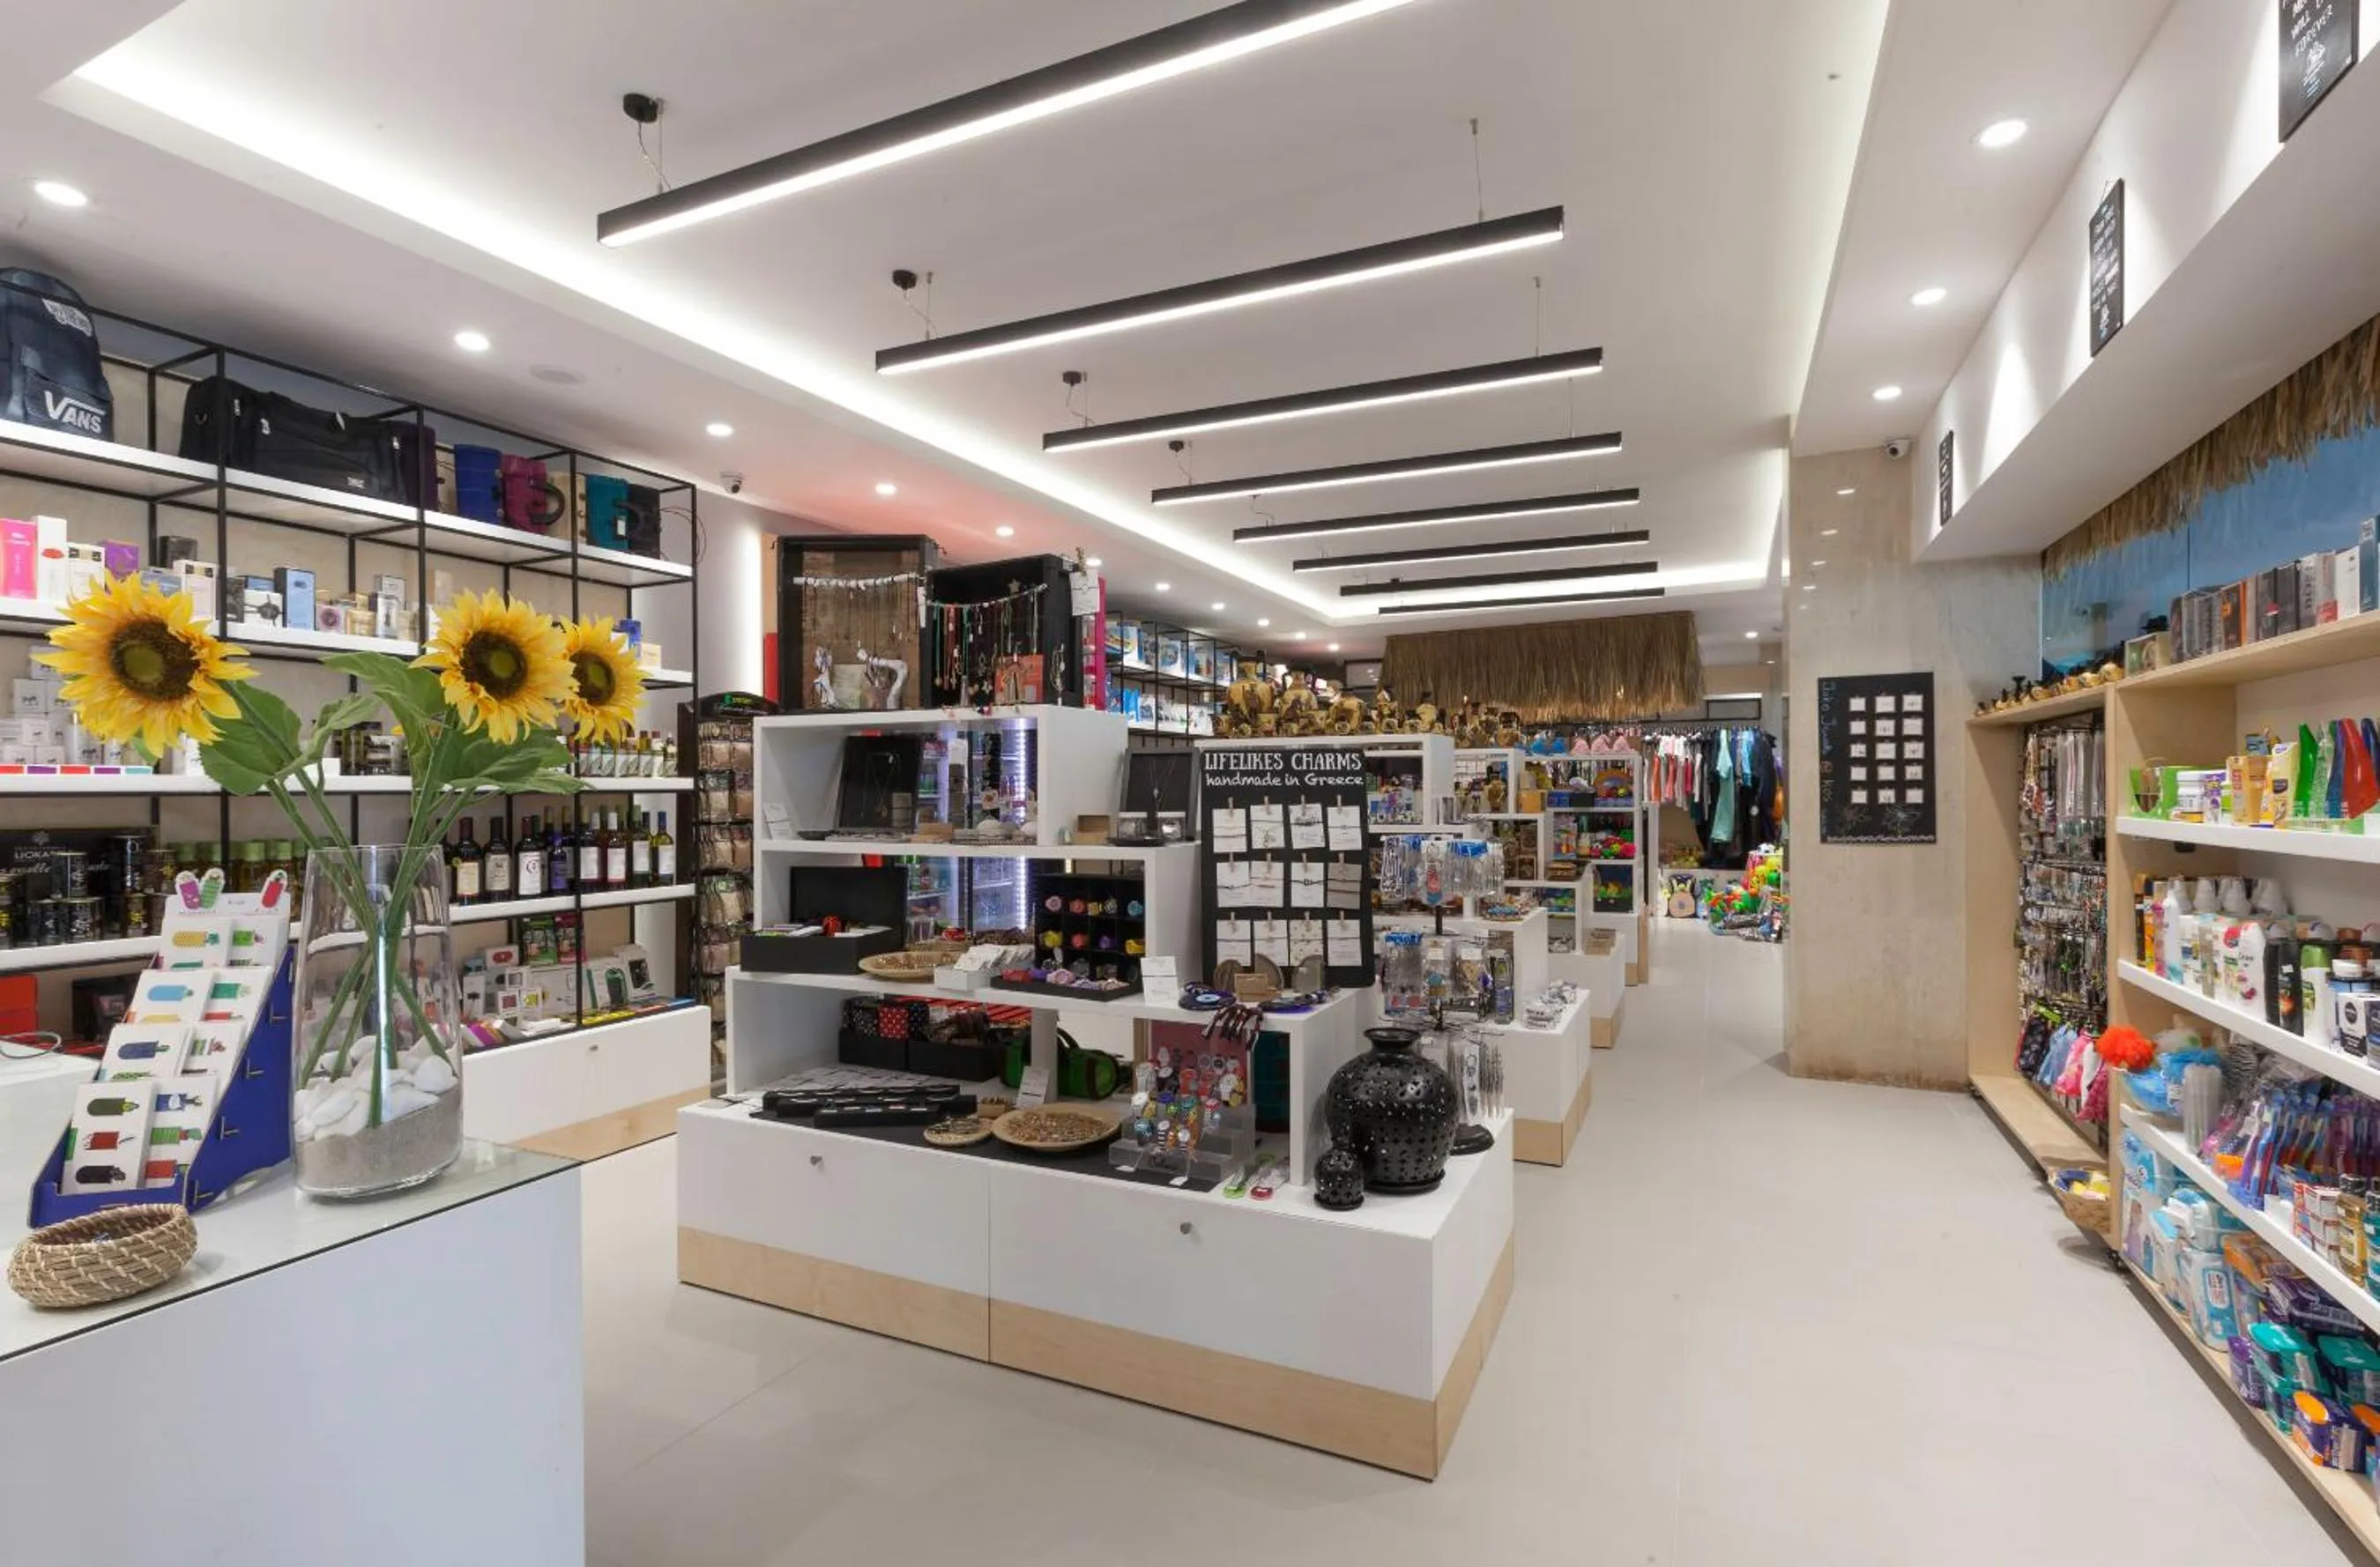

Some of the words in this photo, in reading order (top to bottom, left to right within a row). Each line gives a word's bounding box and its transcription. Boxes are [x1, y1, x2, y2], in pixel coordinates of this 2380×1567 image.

[44, 390, 106, 434] VANS
[1205, 753, 1283, 770] LIFELIKES
[1290, 753, 1362, 770] CHARMS
[1206, 771, 1283, 786] handmade
[1284, 773, 1300, 786] in
[1305, 773, 1364, 785] Greece
